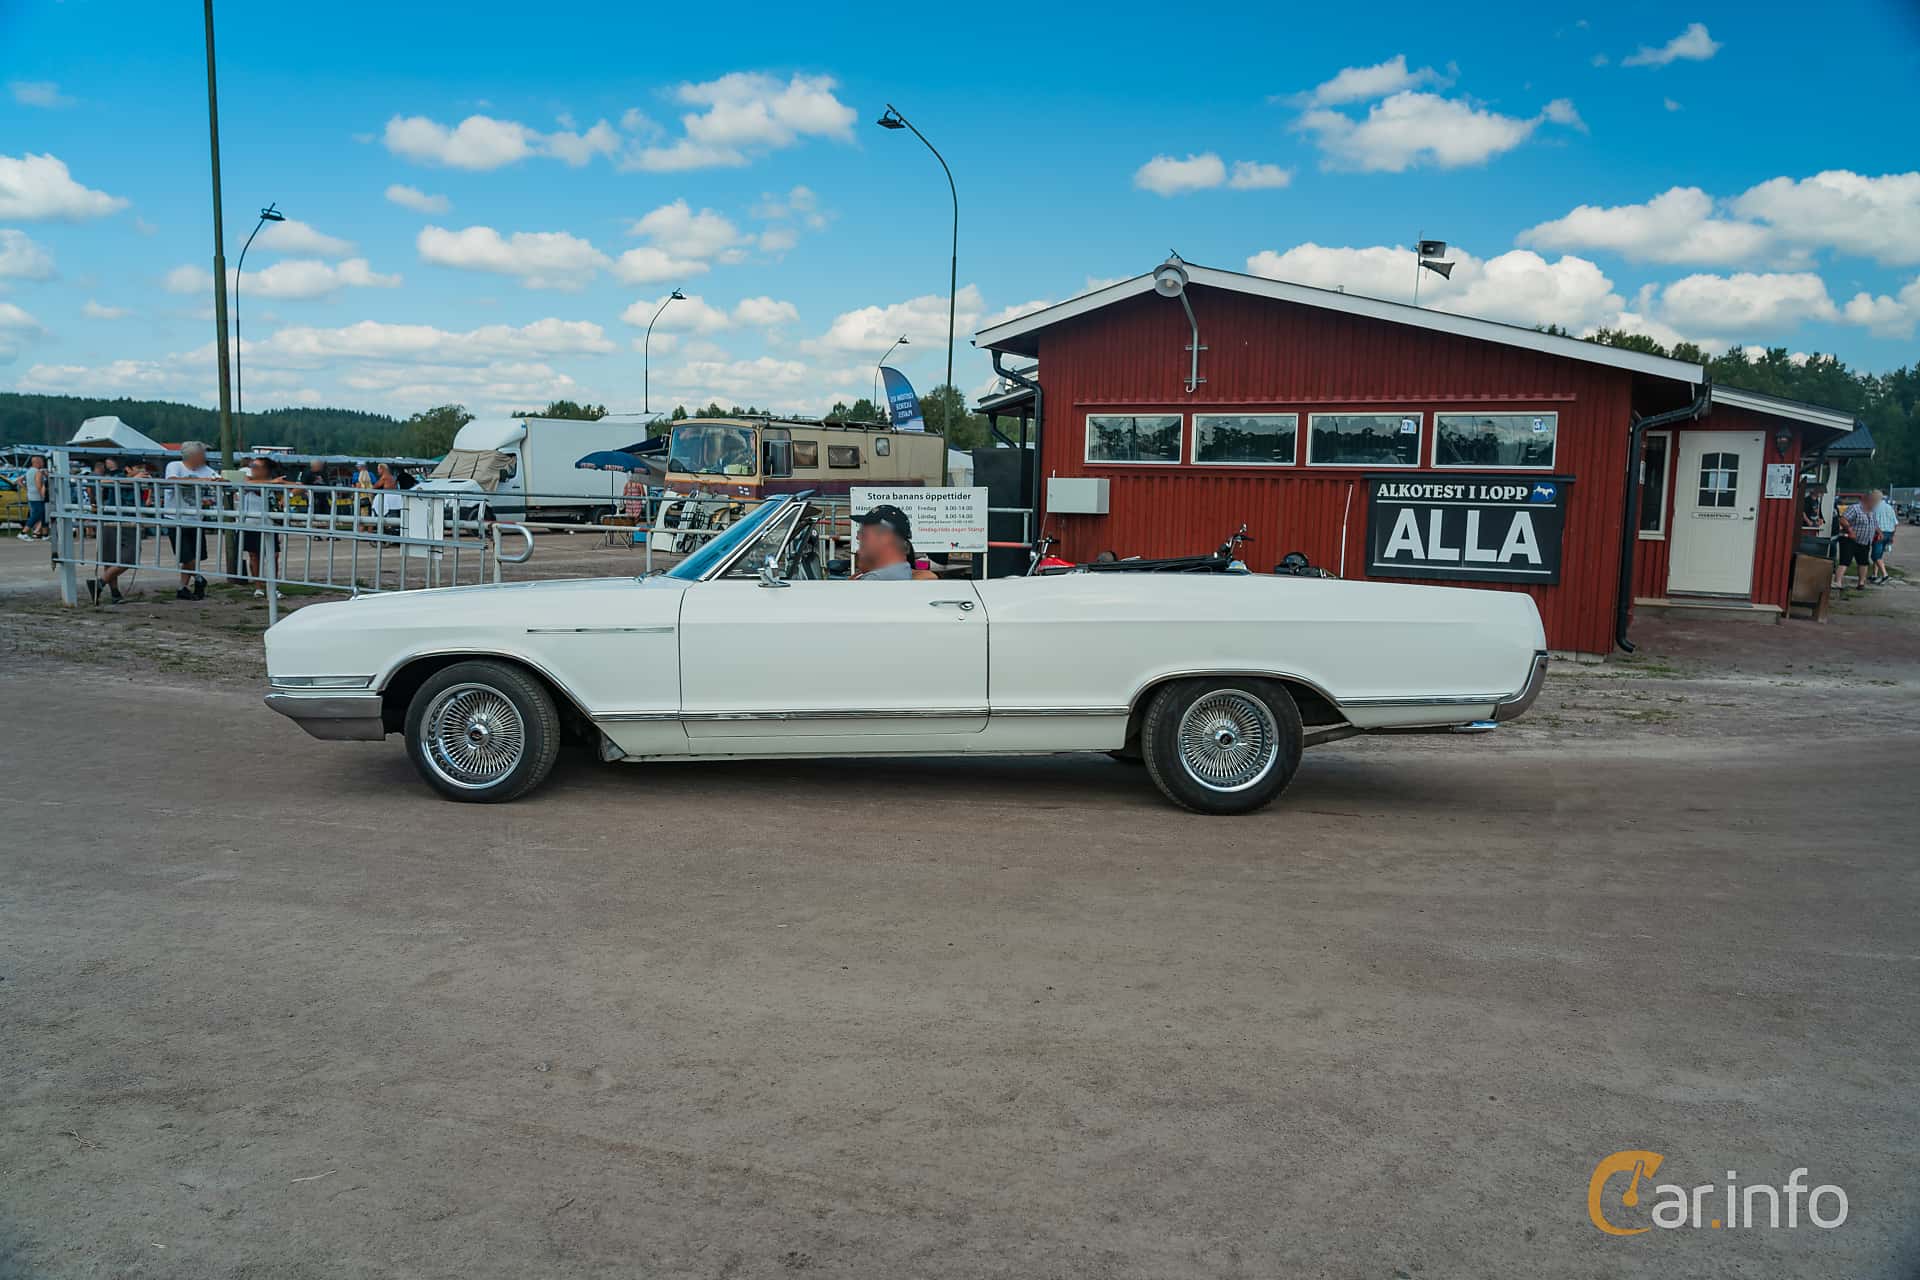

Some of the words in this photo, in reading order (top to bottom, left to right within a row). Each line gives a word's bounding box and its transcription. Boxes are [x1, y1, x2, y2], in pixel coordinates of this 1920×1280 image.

[867, 492, 891, 501] Stora
[892, 491, 924, 501] banans
[925, 491, 972, 502] öppettider
[1377, 483, 1464, 499] ALKOTEST
[1468, 485, 1476, 499] I
[1479, 486, 1528, 501] LOPP
[1384, 508, 1543, 564] ALLA
